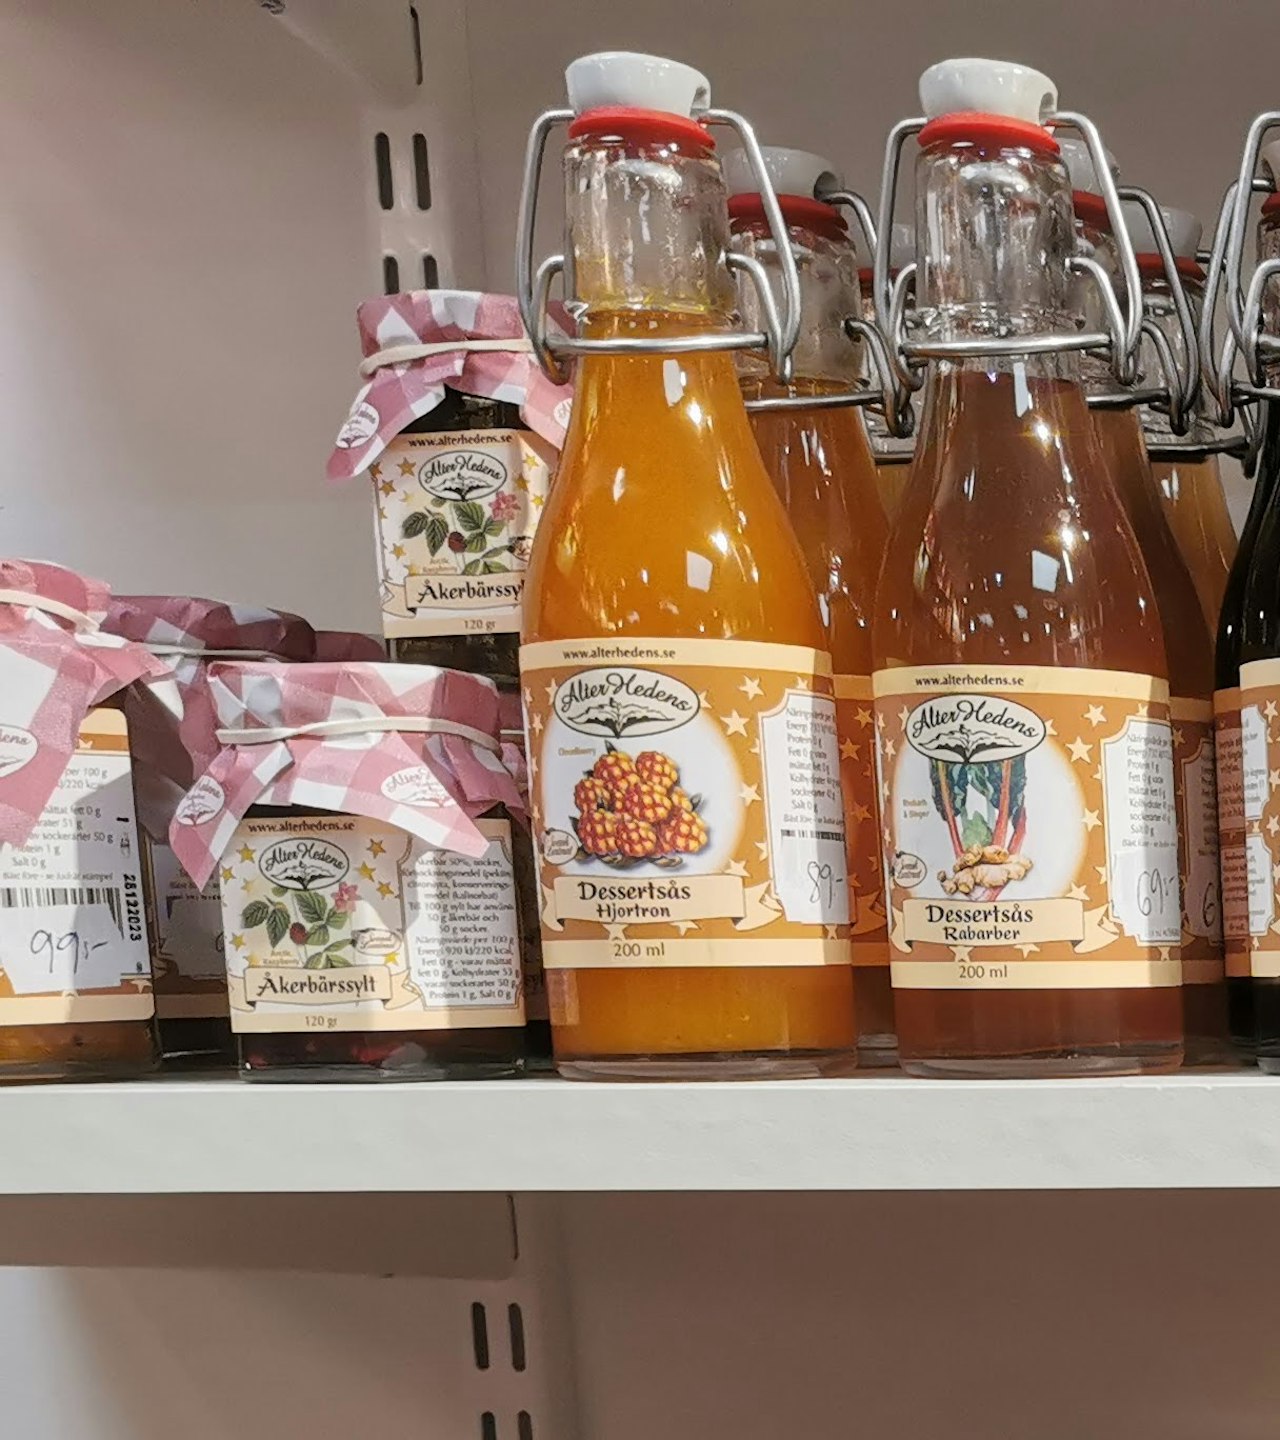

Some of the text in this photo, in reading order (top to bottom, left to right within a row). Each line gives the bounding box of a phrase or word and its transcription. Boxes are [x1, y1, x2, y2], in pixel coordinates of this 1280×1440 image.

[562, 673, 692, 712] Alter Hedens
[912, 700, 1039, 738] Alter Hedens
[577, 880, 691, 901] Dessertsås
[596, 904, 671, 921] Hjortron
[925, 904, 1033, 923] Dessertsås
[944, 926, 1020, 941] Rabarber
[613, 943, 665, 957] 200 ml
[959, 965, 1007, 979] 200 ml
[257, 972, 376, 998] Åkerbärssylt
